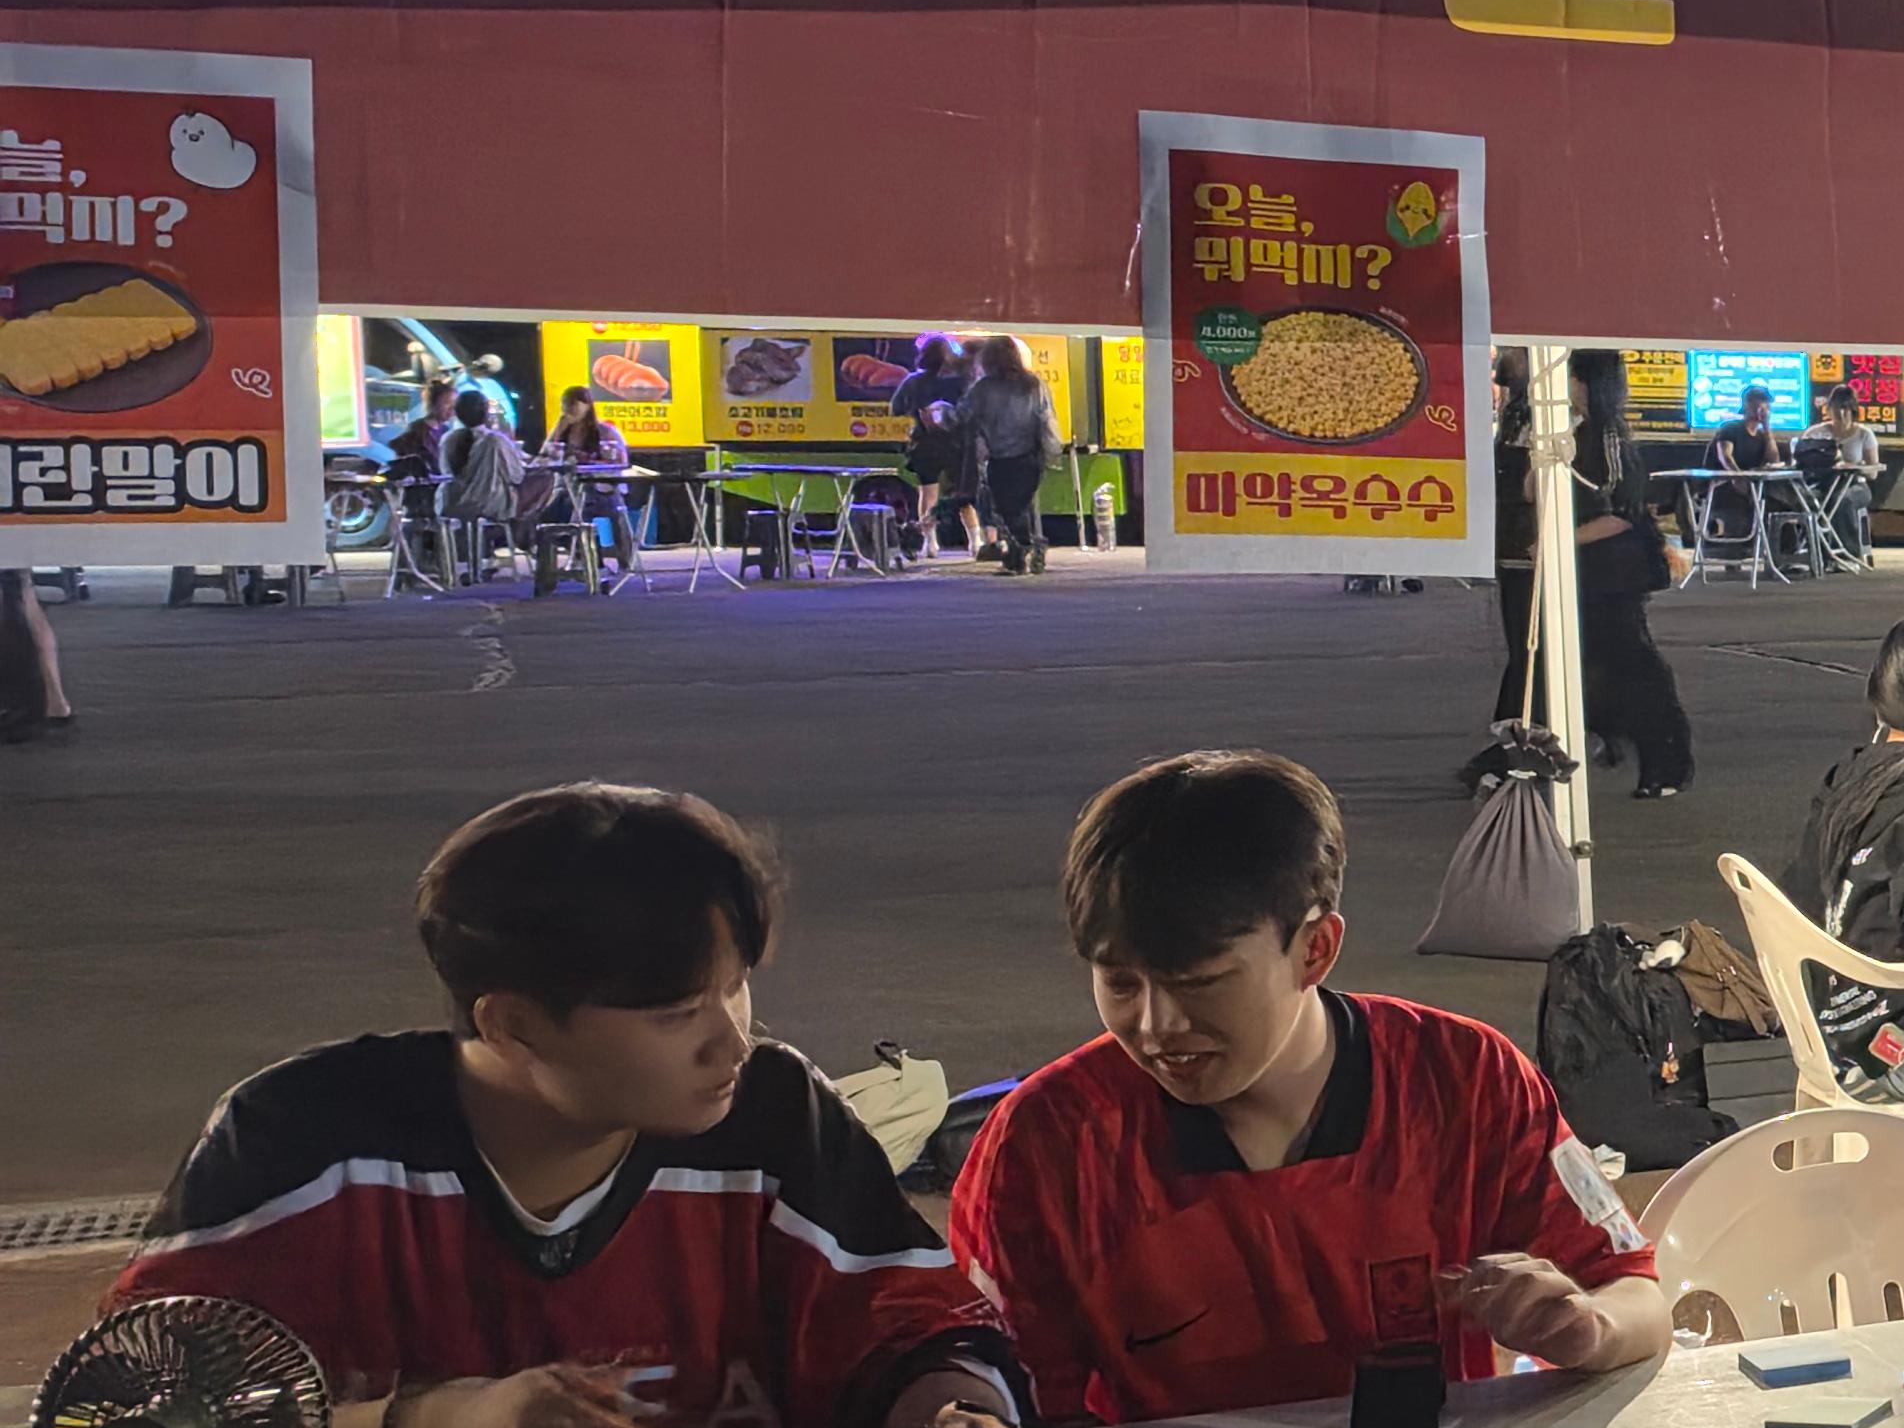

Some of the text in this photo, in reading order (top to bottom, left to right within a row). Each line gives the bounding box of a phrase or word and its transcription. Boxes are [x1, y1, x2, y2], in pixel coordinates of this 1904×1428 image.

[1194, 183, 1314, 237] 오늘,
[0, 437, 262, 508] 란말이
[1186, 470, 1456, 523] 마약옥수수
